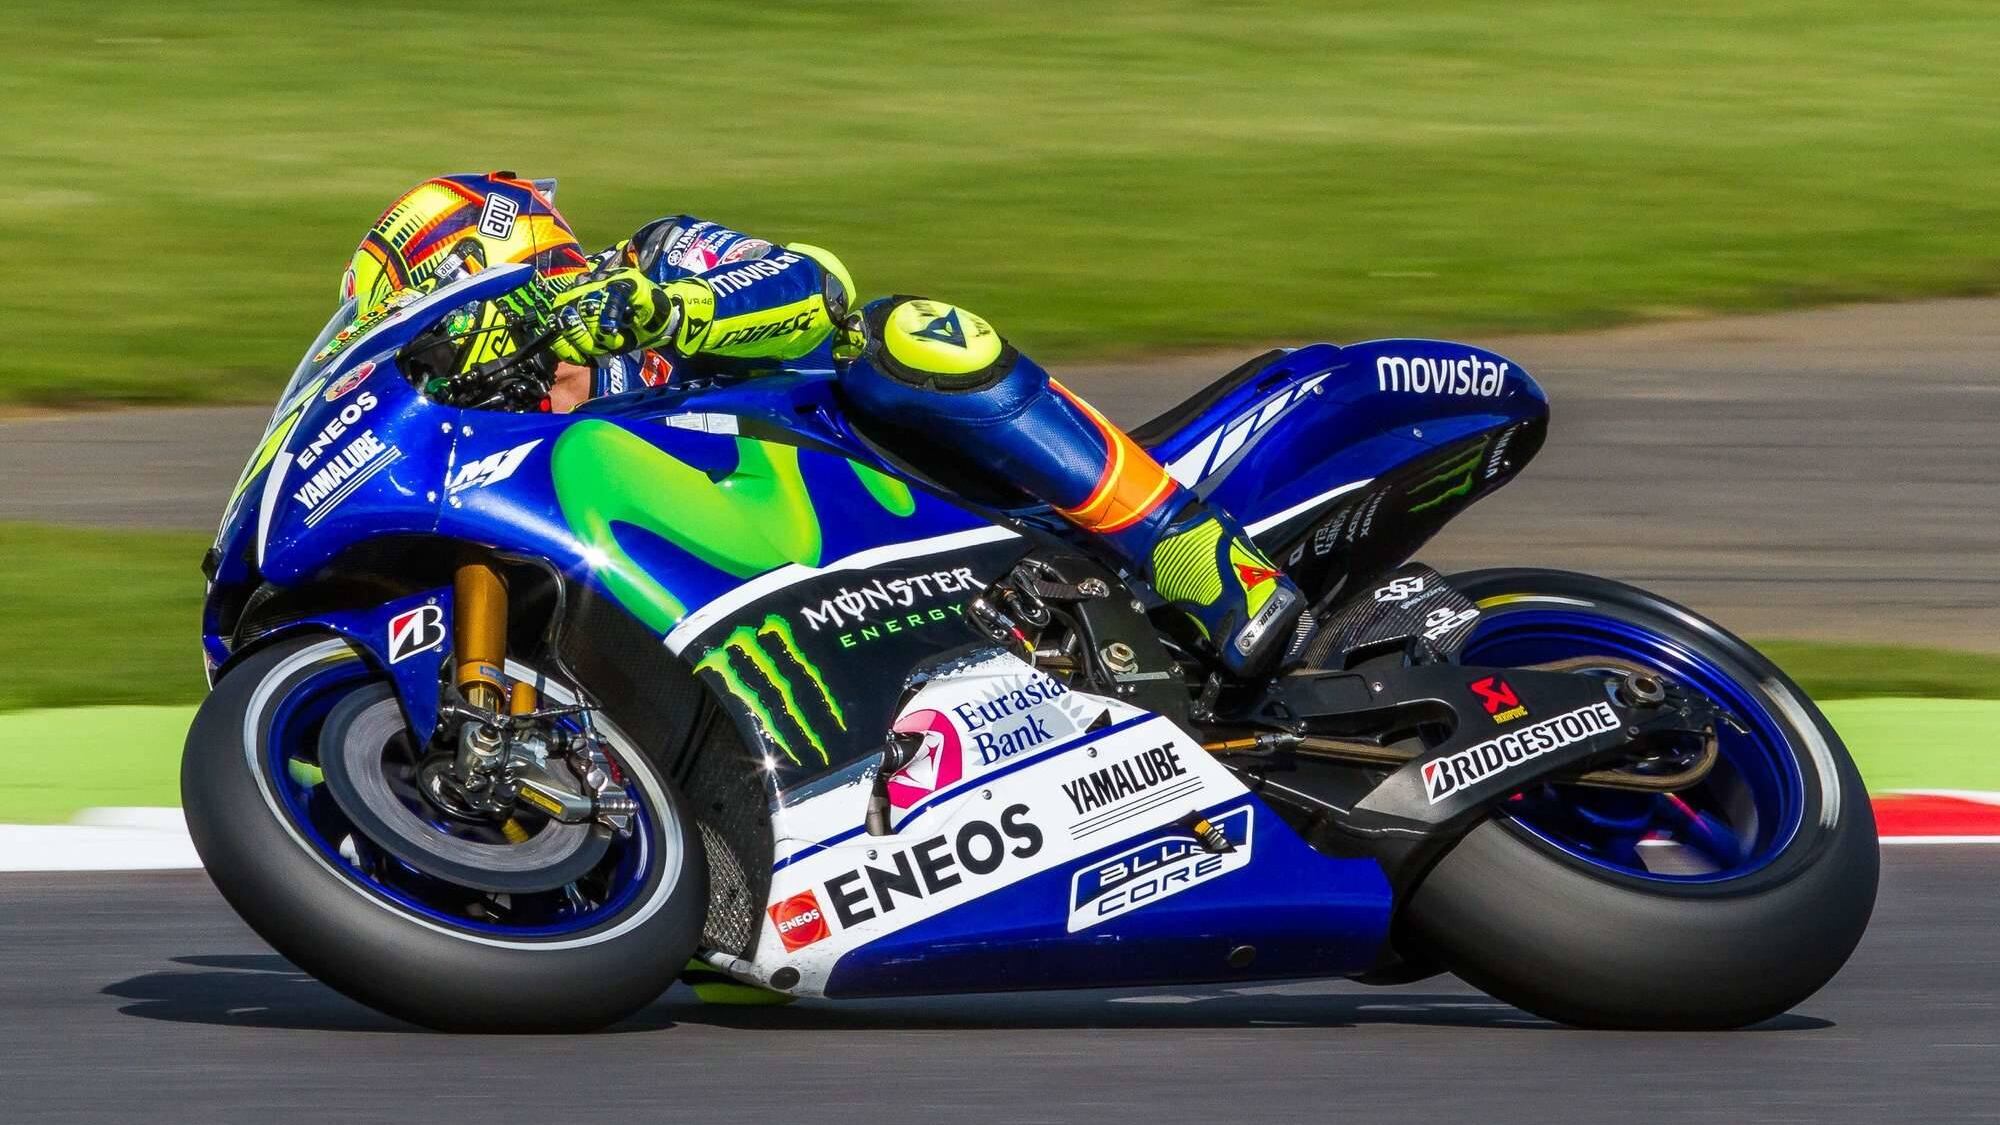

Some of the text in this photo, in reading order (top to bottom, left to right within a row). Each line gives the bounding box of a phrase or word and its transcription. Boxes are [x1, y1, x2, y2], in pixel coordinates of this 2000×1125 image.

[708, 252, 805, 298] movistar
[1377, 355, 1508, 397] movistar
[297, 391, 378, 470] ENEOS
[293, 429, 386, 509] YAMALUBE
[839, 604, 966, 648] ENERGY
[952, 673, 1068, 732] Eurasia
[973, 714, 1054, 766] Bank
[1424, 705, 1617, 800] BRIDGESTONE
[1061, 741, 1187, 815] YAMALUBE
[824, 803, 1044, 929] ENEOS
[1098, 854, 1222, 916] CORE
[779, 908, 820, 933] ENEOS
